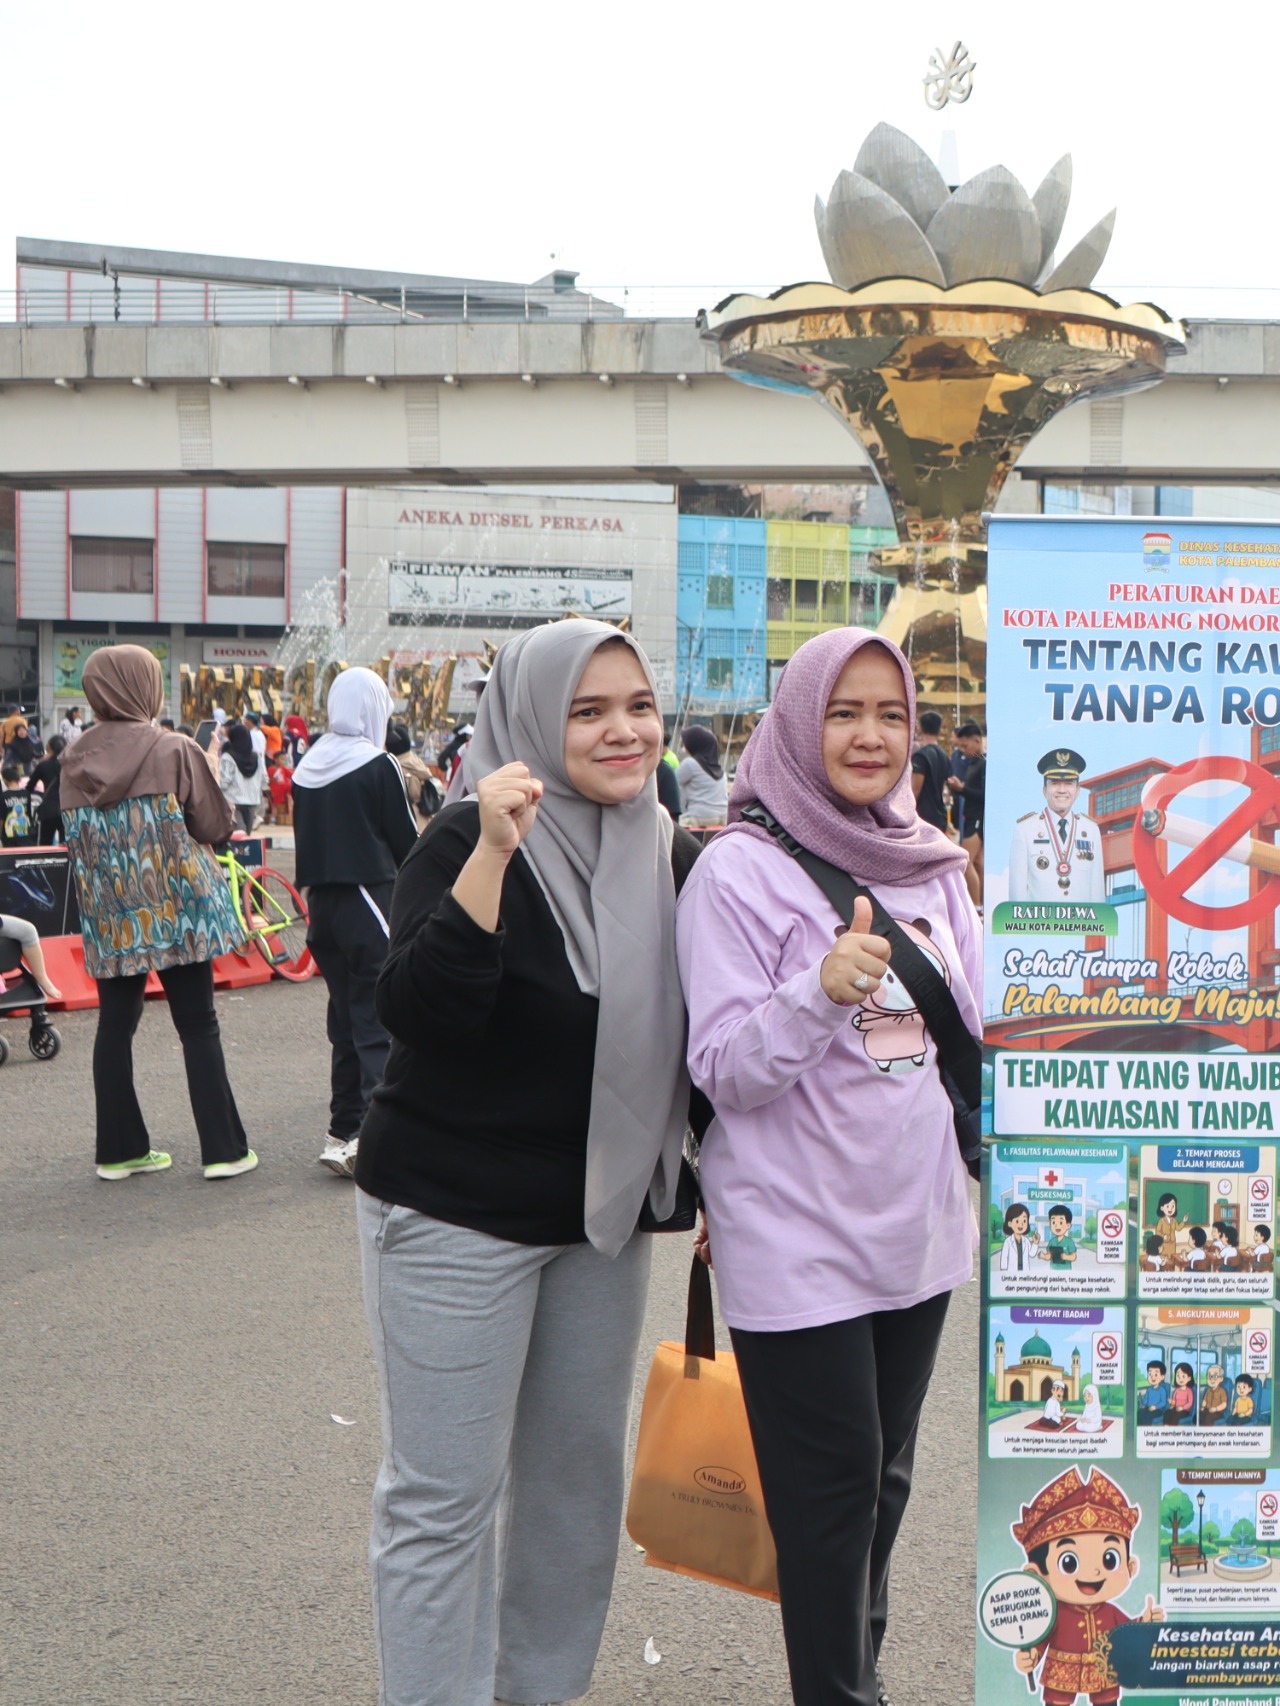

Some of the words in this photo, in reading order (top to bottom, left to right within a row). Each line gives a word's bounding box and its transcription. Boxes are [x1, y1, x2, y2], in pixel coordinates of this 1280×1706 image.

[399, 509, 463, 525] ANEKA
[470, 513, 532, 528] DIESEL
[540, 516, 623, 532] PERKASA
[1179, 541, 1220, 553] DINAS
[1179, 554, 1213, 566] KOTA
[410, 564, 490, 576] FIRMAN
[496, 569, 561, 578] PALEMBANG
[1109, 584, 1233, 604] PERATURAN
[1003, 610, 1059, 628] KOTA
[1064, 611, 1192, 630] PALEMBANG
[1198, 614, 1280, 633] NOMOR
[214, 648, 267, 657] HONDA
[1023, 639, 1202, 672] TENTANG
[1044, 683, 1204, 723] TANPA
[1012, 905, 1052, 920] RATU
[1055, 906, 1097, 920] DEWA
[1004, 923, 1027, 932] WALI
[1029, 923, 1050, 932] KOTA
[1053, 924, 1105, 934] PALEMBANG
[1004, 949, 1076, 978] Sehat
[1080, 952, 1157, 982] Tanpa
[1003, 985, 1180, 1024] Palembang
[1003, 1059, 1109, 1089] TEMPAT
[1117, 1060, 1189, 1091] YANG
[1043, 1099, 1179, 1130] KAWASAN
[1188, 1100, 1273, 1131] TANPA
[1010, 1148, 1041, 1156] FASILITAS
[1042, 1149, 1080, 1157] PELAYANAN
[1081, 1149, 1118, 1157] KESEHATAN
[1185, 1150, 1212, 1158] TEMPAT
[1214, 1150, 1241, 1158] PROSES
[1173, 1160, 1204, 1168] BELAJAR
[1206, 1160, 1244, 1168] MENGAJAR
[1030, 1191, 1071, 1200] PUSKESMAS
[1088, 1276, 1116, 1284] kesehatan,
[1163, 1276, 1192, 1284] melindungi
[1025, 1310, 1032, 1318] 4.
[1034, 1310, 1061, 1318] TEMPAT
[1063, 1310, 1090, 1318] IBADAH
[1168, 1310, 1174, 1318] 5.
[1176, 1310, 1215, 1318] ANGKUTAN
[1216, 1310, 1239, 1318] UMUM
[699, 1472, 741, 1489] Amanda
[1188, 1471, 1212, 1479] TEMPAT
[679, 1493, 700, 1504] TRULY
[703, 1498, 742, 1512] BROWNIES
[990, 1591, 1011, 1604] ASAP
[1012, 1587, 1040, 1600] ROKOK
[993, 1599, 1041, 1615] MERUGIKAN
[990, 1615, 1019, 1628] SEMUA
[1020, 1610, 1049, 1623] ORANG
[1158, 1628, 1255, 1642] Kesehatan
[1150, 1643, 1235, 1659] investasi
[1150, 1660, 1192, 1672] Jangan
[1195, 1659, 1239, 1670] biarkan
[1242, 1661, 1272, 1672] asap
[1212, 1698, 1272, 1706] Palembang
